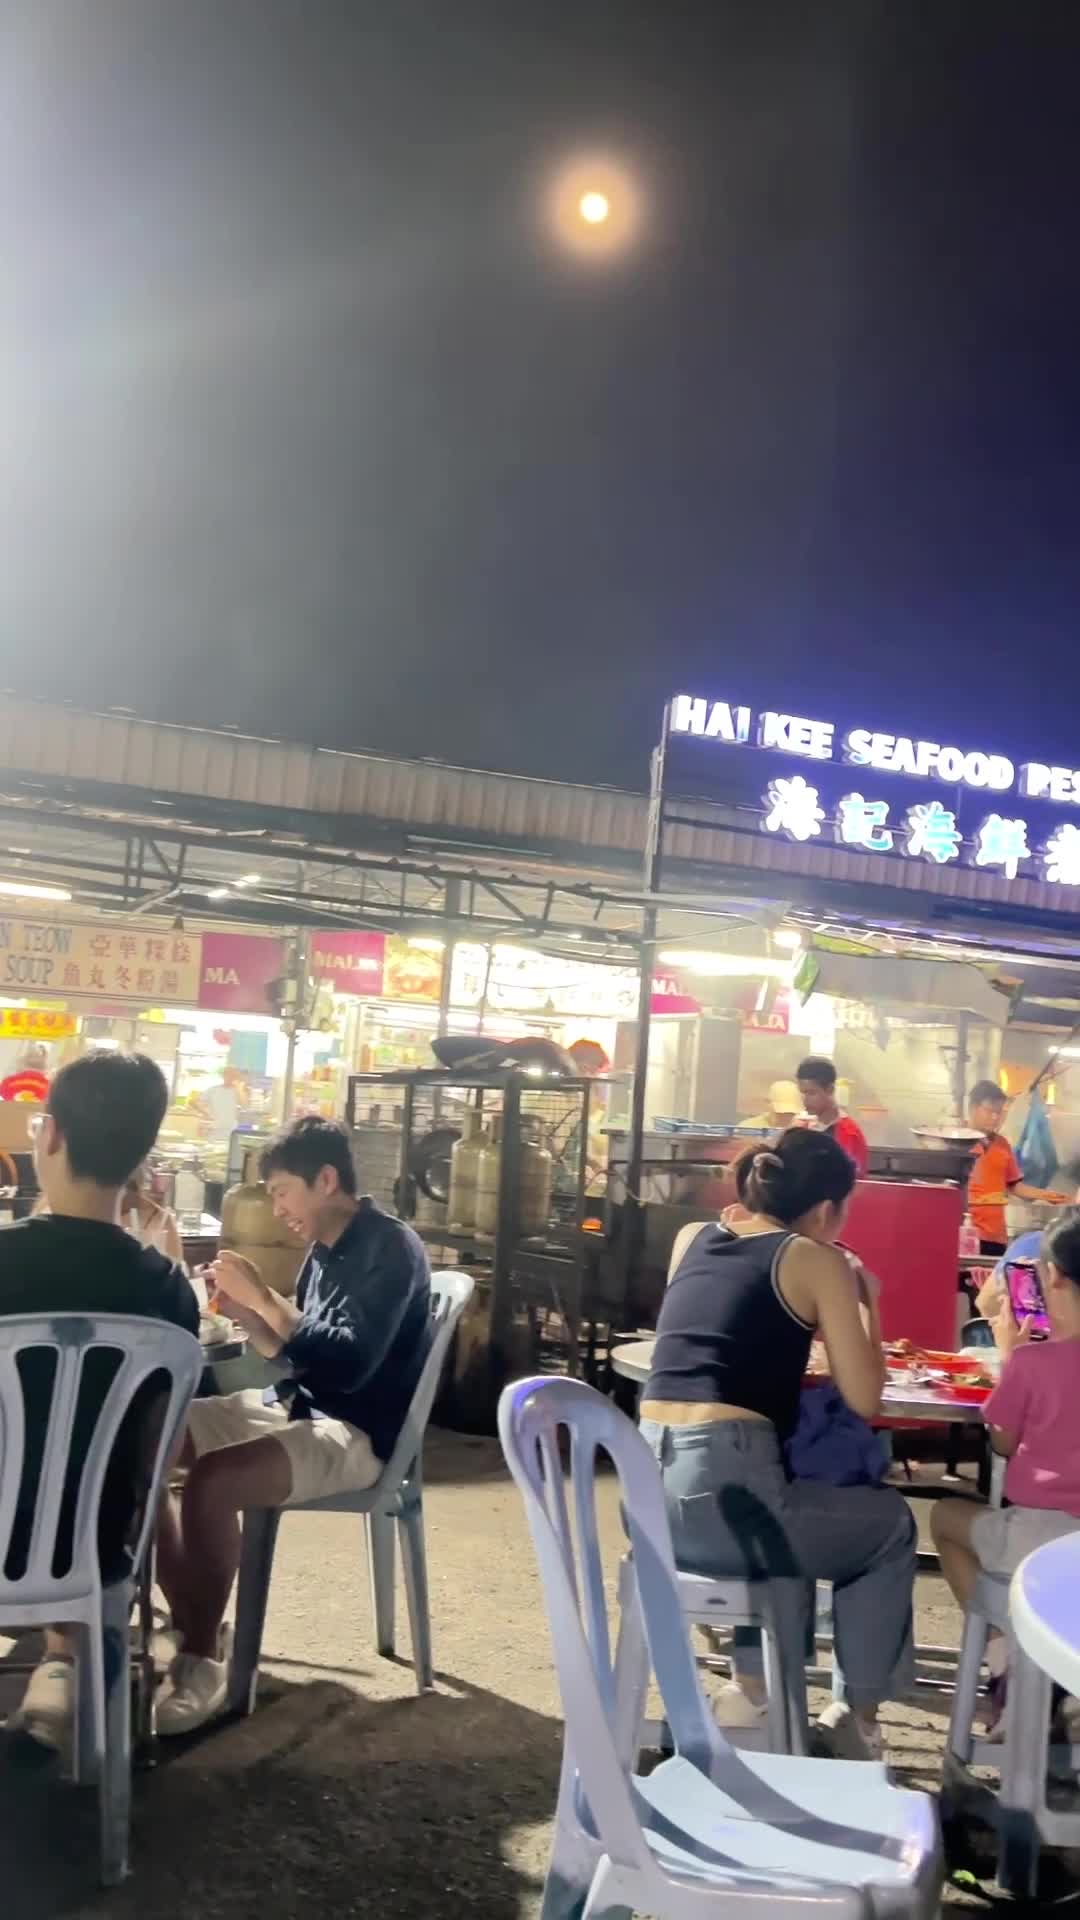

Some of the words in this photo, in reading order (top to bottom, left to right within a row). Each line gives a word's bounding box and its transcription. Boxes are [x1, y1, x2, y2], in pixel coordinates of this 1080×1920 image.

[672, 694, 751, 743] HAI
[759, 712, 835, 761] KEE
[846, 728, 1016, 792] SEAFOOD
[4, 953, 55, 985] SOUP
